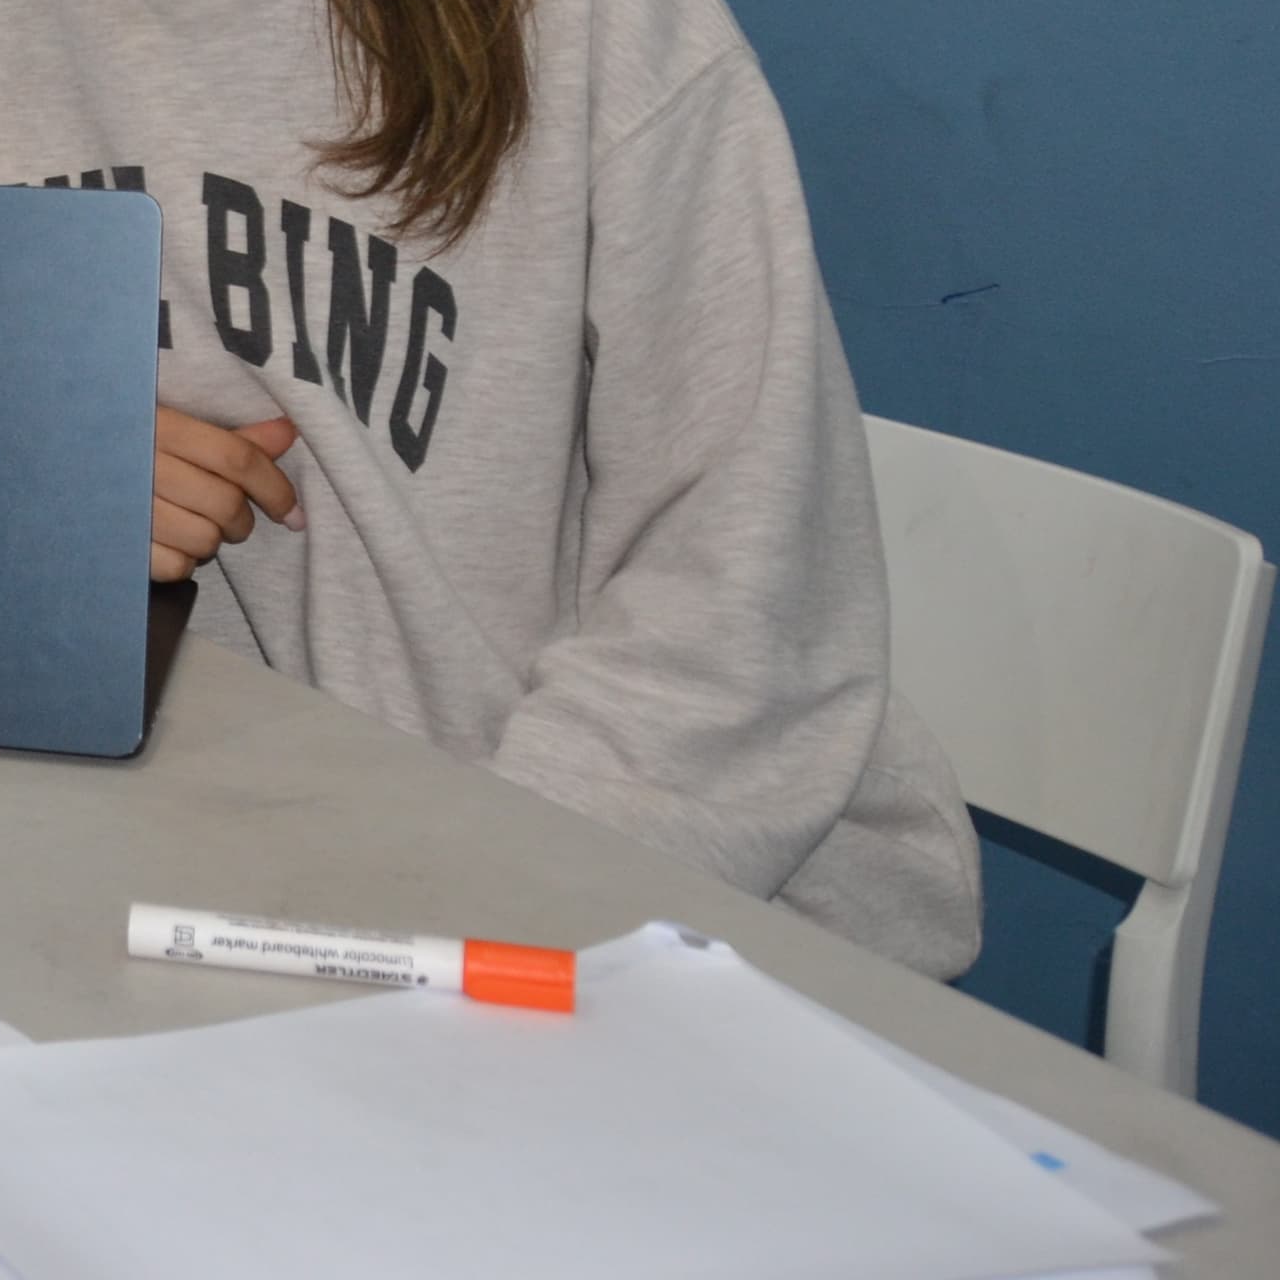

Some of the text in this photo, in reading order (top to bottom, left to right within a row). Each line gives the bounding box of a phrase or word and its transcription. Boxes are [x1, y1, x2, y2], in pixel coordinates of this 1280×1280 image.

[202, 171, 458, 475] BING
[210, 934, 415, 969] Lumocolor whiteboard marker
